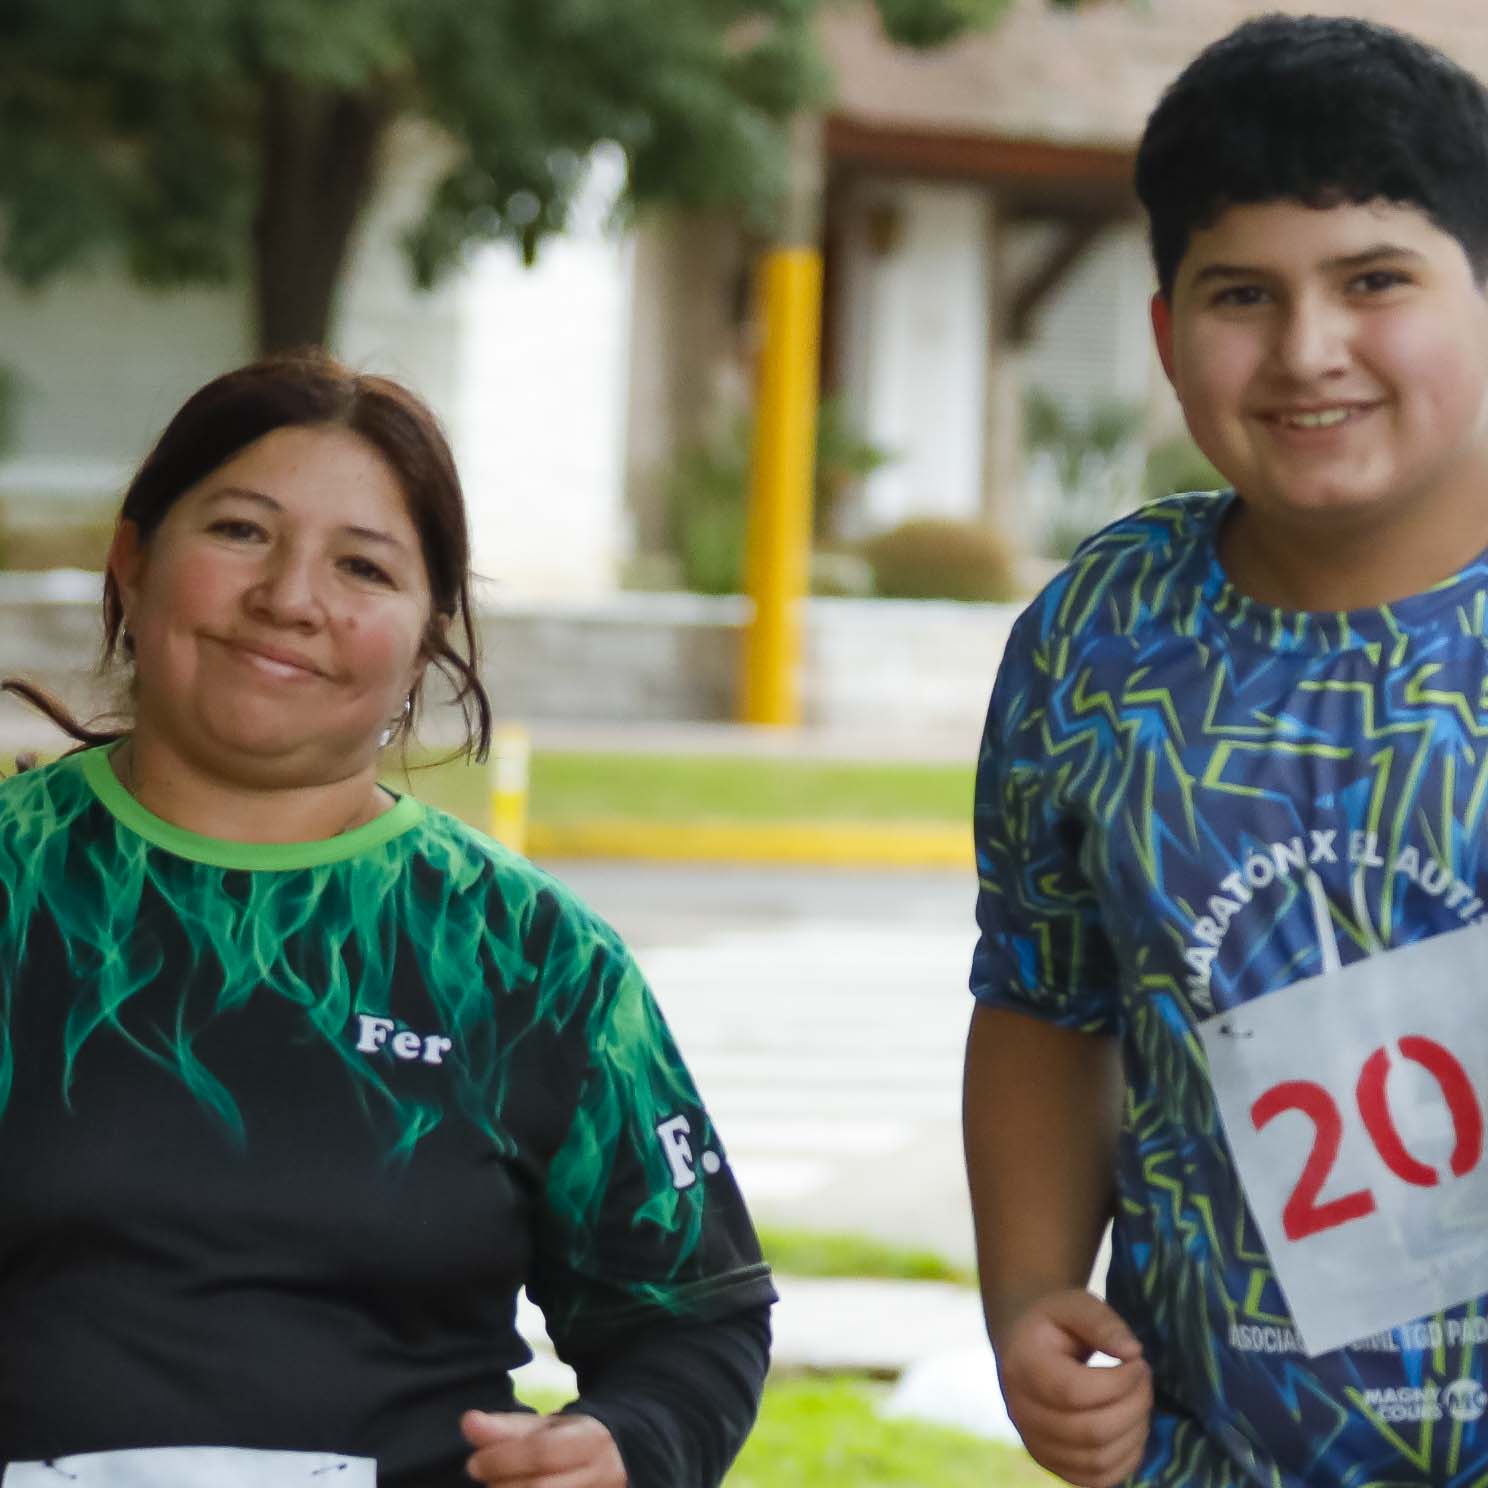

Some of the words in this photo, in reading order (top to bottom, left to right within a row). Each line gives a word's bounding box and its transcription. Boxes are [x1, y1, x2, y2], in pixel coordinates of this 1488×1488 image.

[1309, 829, 1339, 864] X
[1348, 829, 1385, 867] EL
[356, 1013, 452, 1065] Fer
[1228, 1323, 1306, 1353] ASOCIA
